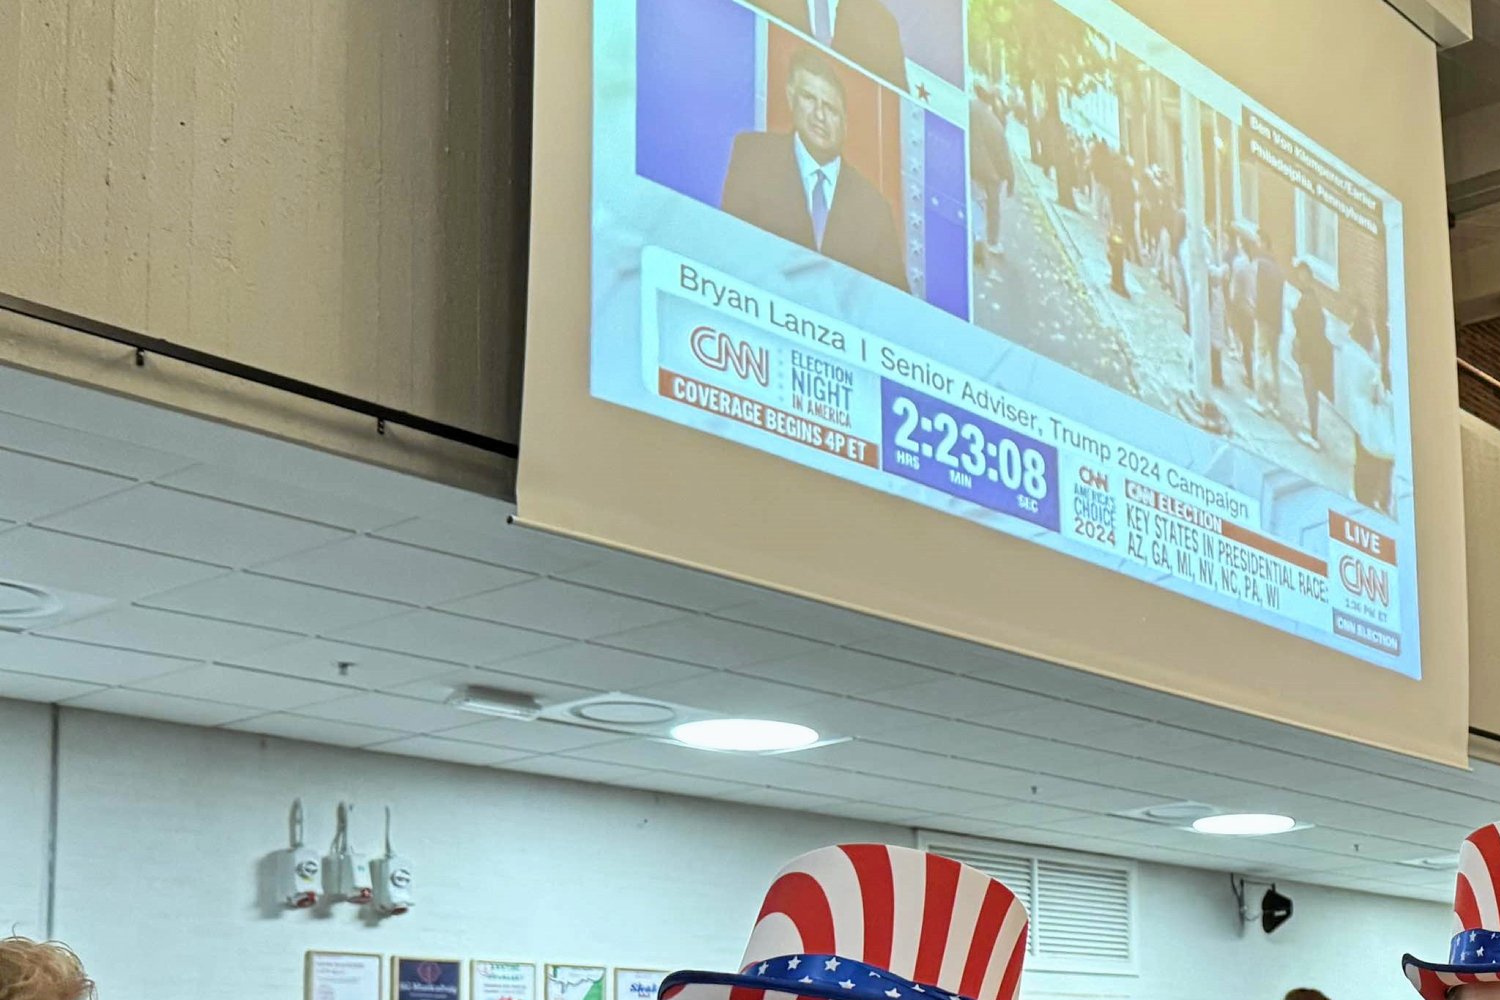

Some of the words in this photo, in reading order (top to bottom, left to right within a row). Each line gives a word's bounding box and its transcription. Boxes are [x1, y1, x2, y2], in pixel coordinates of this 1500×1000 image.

[690, 326, 769, 388] CNN
[791, 350, 853, 386] ELECTION
[680, 263, 759, 318] Bryan
[770, 300, 846, 353] Lanza
[881, 346, 954, 394] Senior
[961, 381, 1043, 437] Adviser,
[1050, 417, 1111, 462] Trump
[1117, 447, 1160, 481] 2024
[1167, 468, 1249, 519] Campaign
[791, 368, 853, 411] NIGHT
[673, 377, 763, 425] COVERAGE
[765, 409, 822, 446] BEGINS
[825, 434, 845, 453] 4P
[847, 437, 866, 461] ET
[793, 394, 803, 410] IN
[807, 400, 852, 429] AMERICA
[892, 396, 1047, 500] 2:23:08
[896, 450, 920, 470] HRS
[949, 469, 972, 489] MIN
[1079, 465, 1109, 493] CNN
[1017, 494, 1038, 513] SEC
[1074, 496, 1116, 529] CHOICE
[1159, 495, 1222, 534] ELECTION
[1074, 517, 1116, 546] 2024
[1344, 520, 1381, 554] LIVE
[1126, 503, 1150, 535] KEY
[1155, 514, 1199, 554] STATES
[1203, 533, 1214, 560] IN
[1218, 540, 1295, 591] PRESIDENTIAL
[1298, 571, 1329, 604] RACE:
[1128, 531, 1148, 561] AZ,
[1152, 541, 1172, 575] GA,
[1177, 549, 1196, 583] MI,
[1200, 557, 1218, 591] NV,
[1221, 567, 1241, 599] NC,
[1244, 575, 1264, 606] PA,
[1266, 583, 1281, 609] WI
[1339, 555, 1389, 608] CNN
[1357, 622, 1398, 650] ELECTION
